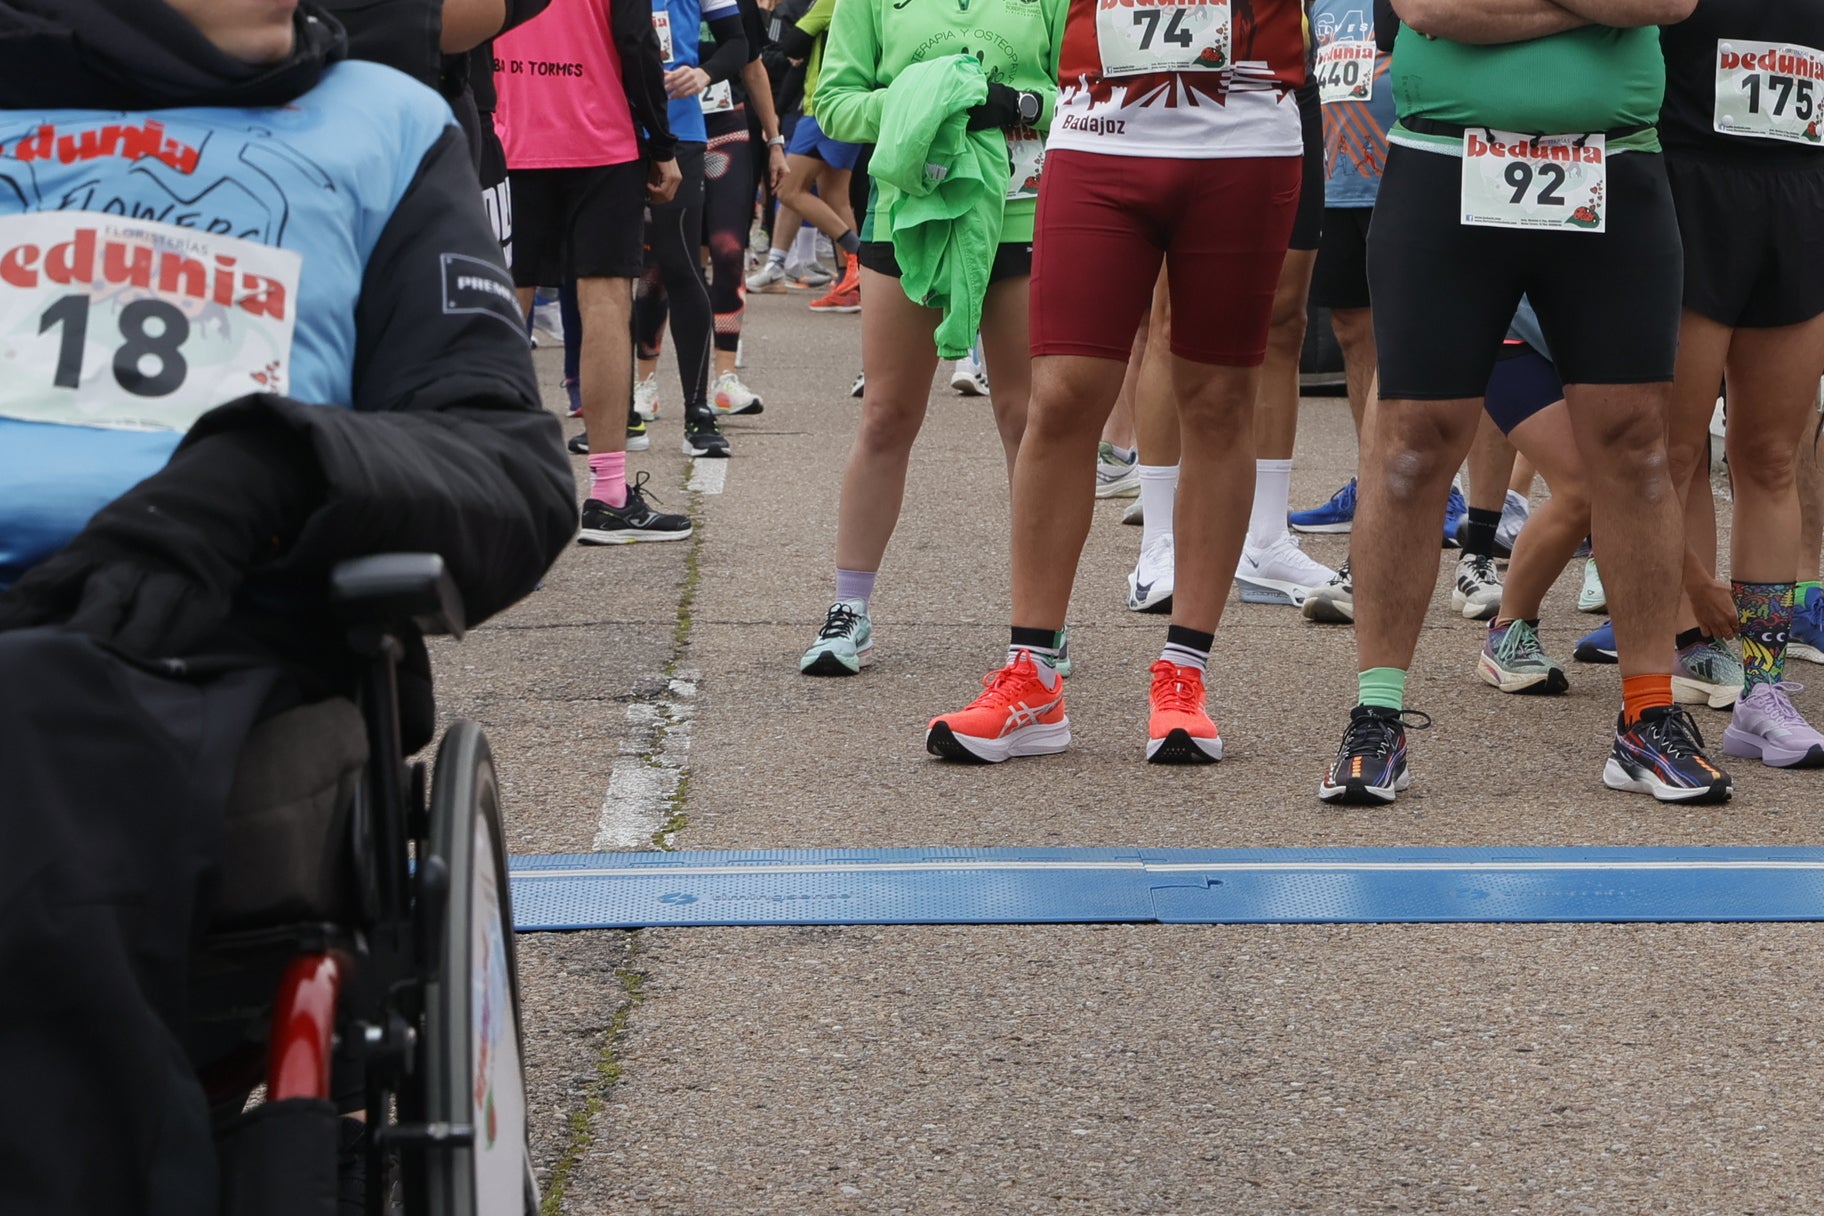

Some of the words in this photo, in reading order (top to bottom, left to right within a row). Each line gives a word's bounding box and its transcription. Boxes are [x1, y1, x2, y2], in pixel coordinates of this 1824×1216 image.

[911, 29, 956, 62] TERAPIA
[1133, 8, 1193, 50] 74
[511, 60, 523, 73] DE
[530, 61, 583, 77] TORMES
[1720, 49, 1824, 81] bedunia
[1742, 74, 1813, 121] 175
[1062, 114, 1126, 136] Badajoz
[1467, 134, 1602, 164] bedunia
[1504, 161, 1566, 206] 92
[0, 229, 286, 322] edunia
[37, 294, 190, 398] 18
